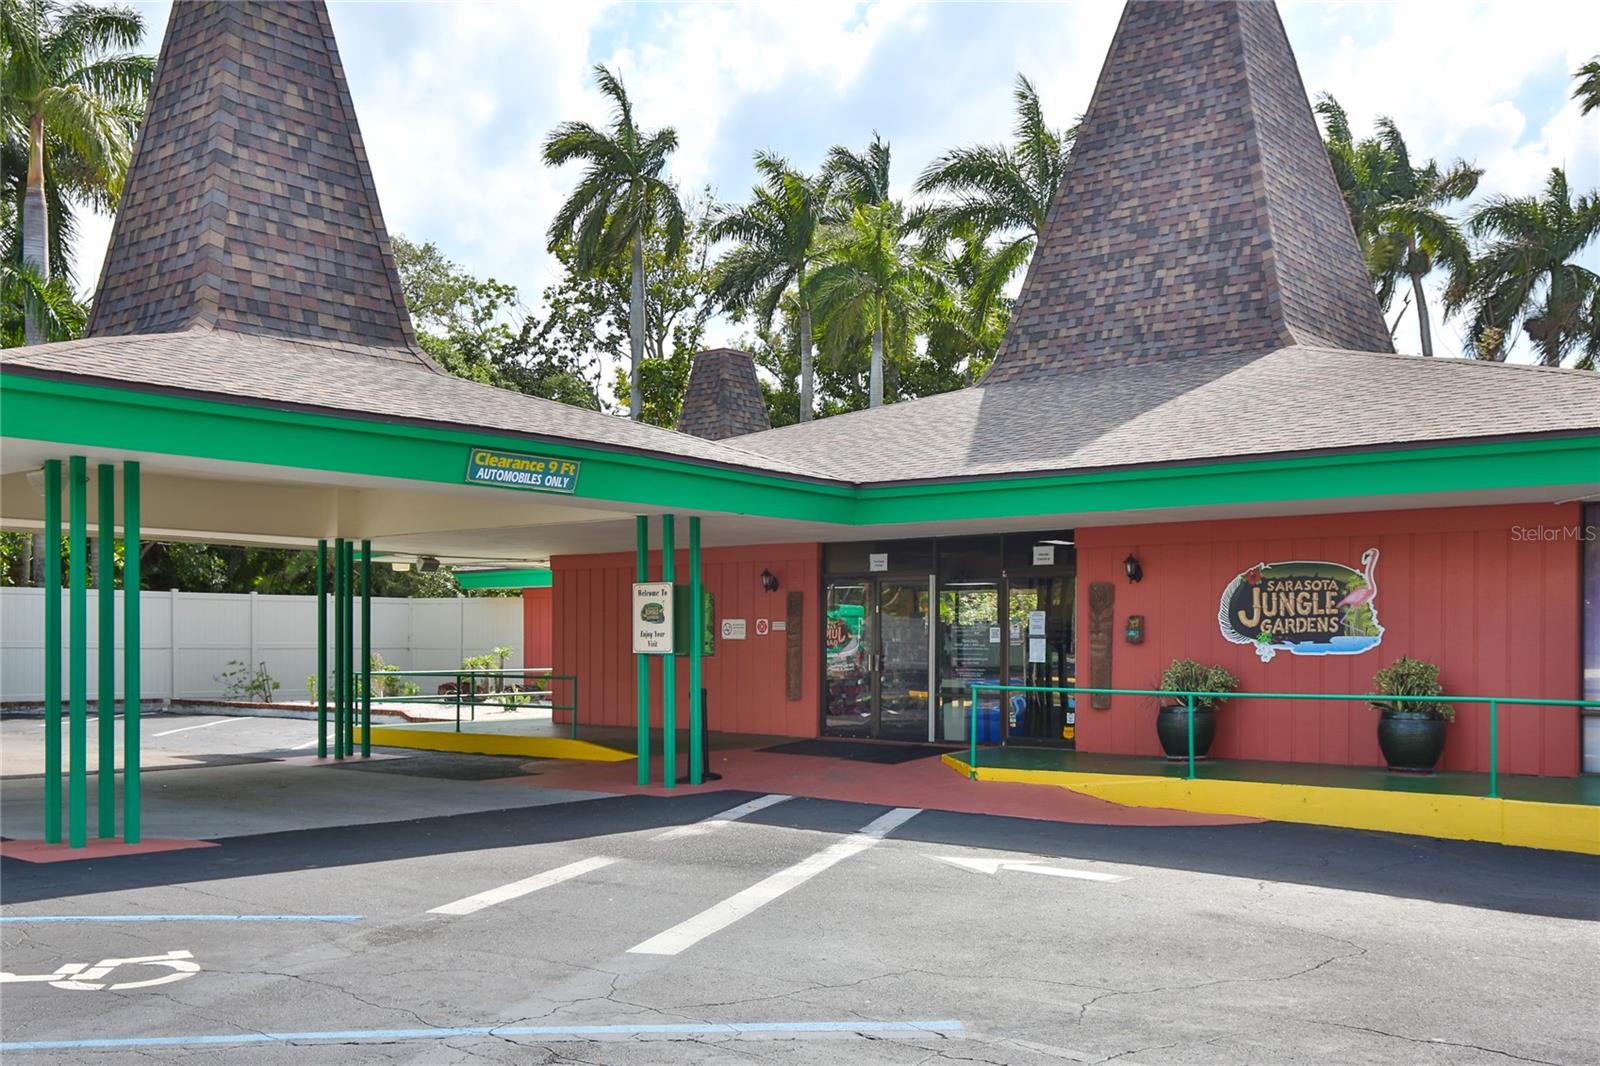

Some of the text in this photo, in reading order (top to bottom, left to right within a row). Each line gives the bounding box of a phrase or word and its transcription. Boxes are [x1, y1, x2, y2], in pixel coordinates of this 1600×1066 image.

[475, 452, 576, 476] Clearance 9 Ft
[476, 467, 570, 488] AUTOMOBILES ONLY
[638, 589, 659, 597] Welcome
[1266, 579, 1339, 592] SARASOTA
[1237, 587, 1339, 628] JUNGLE
[640, 630, 653, 639] Enjoy
[1260, 616, 1339, 635] GARDENS
